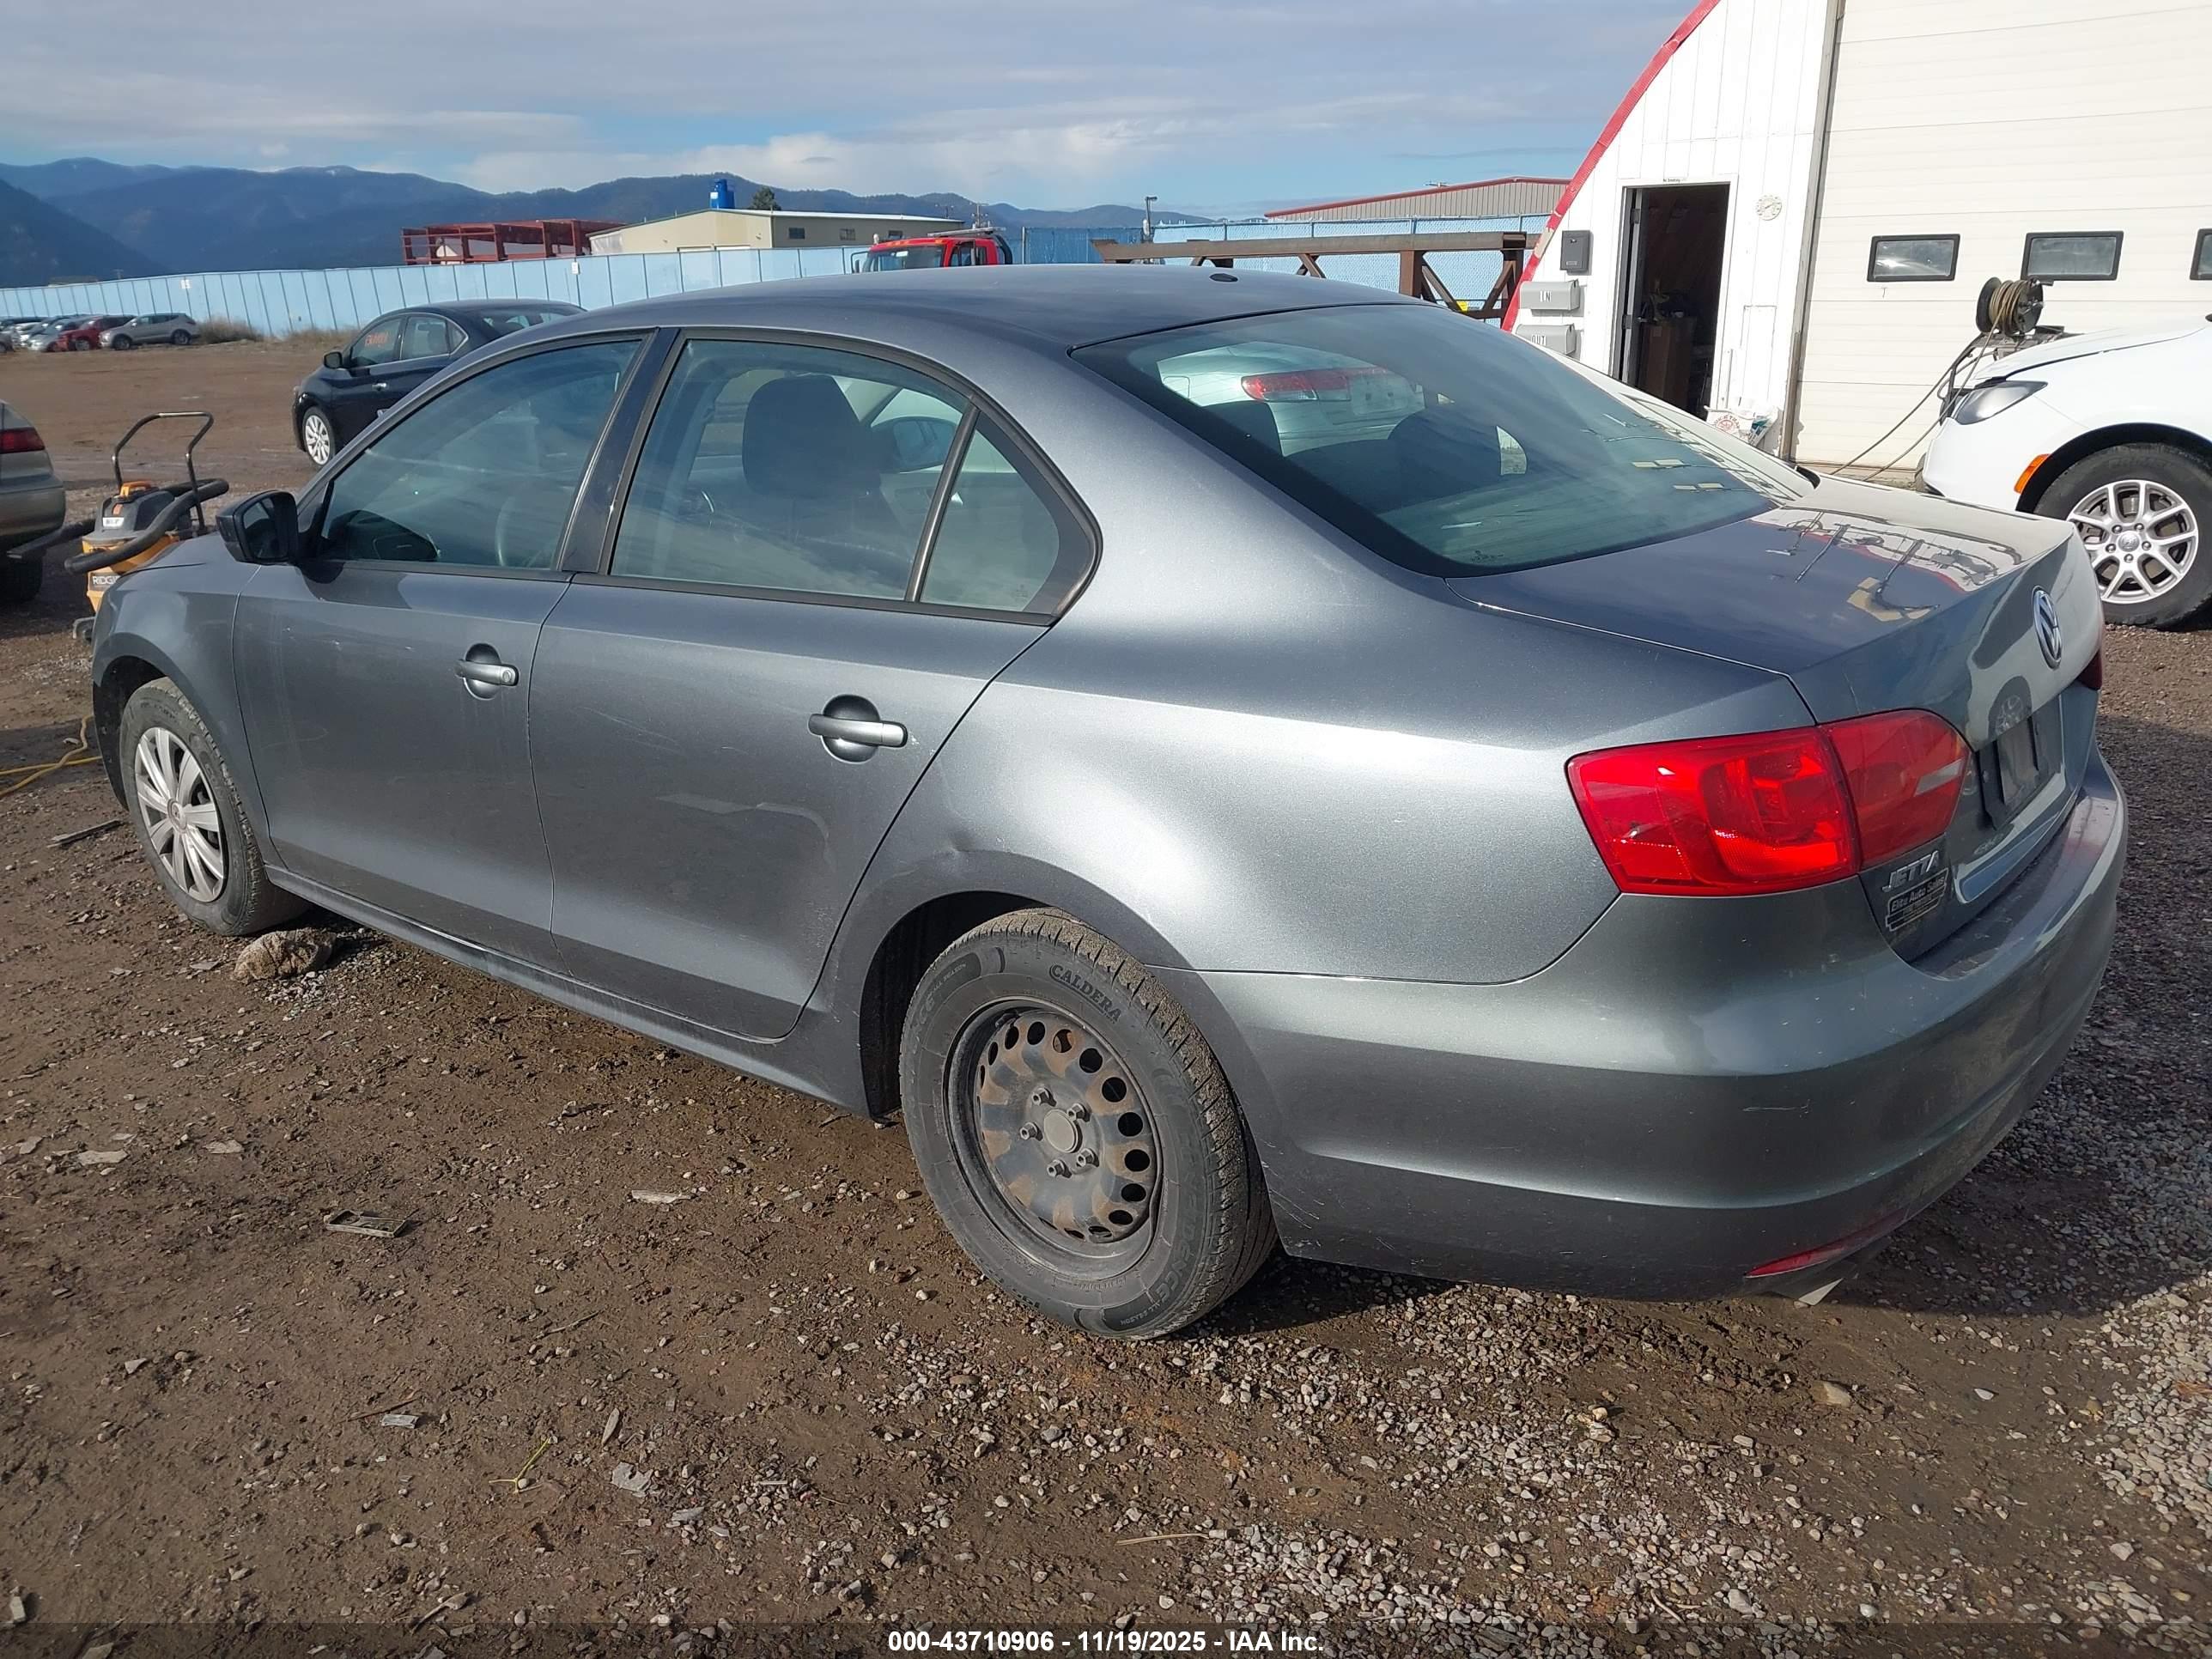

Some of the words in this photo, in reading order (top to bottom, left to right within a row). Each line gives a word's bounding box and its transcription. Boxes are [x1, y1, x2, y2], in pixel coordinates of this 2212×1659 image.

[1540, 290, 1551, 302] IN
[1881, 850, 1939, 893] JETTA
[1909, 887, 1926, 902] Auto
[1050, 963, 1122, 1022] CALDERA
